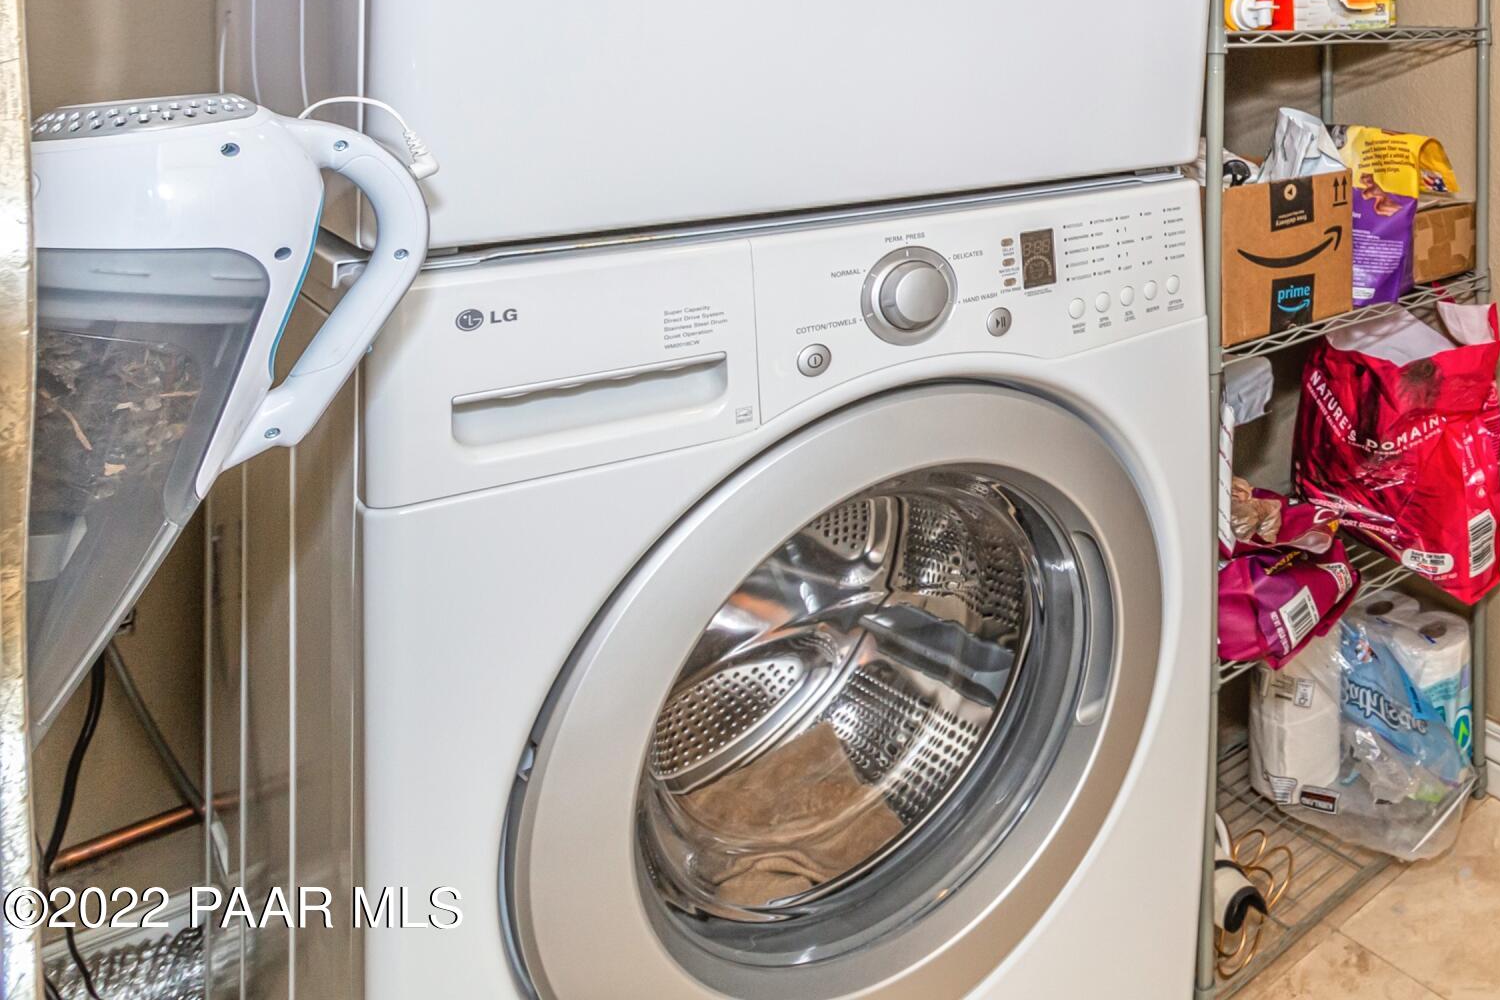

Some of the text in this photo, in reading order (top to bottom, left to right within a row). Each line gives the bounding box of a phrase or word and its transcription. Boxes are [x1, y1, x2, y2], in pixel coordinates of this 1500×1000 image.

[905, 231, 925, 241] PRESS
[952, 250, 984, 261] DELICATES
[830, 268, 861, 279] NORMAL
[962, 291, 998, 304] HAND WASH
[1277, 285, 1310, 304] prime
[683, 305, 711, 313] Capacity
[490, 308, 518, 325] LG
[701, 311, 724, 319] System
[663, 324, 692, 332] Stainless
[796, 317, 858, 335] COTTON/TOWELS
[682, 329, 713, 338] Operation
[1309, 370, 1440, 451] NATURE'S DOMAIN
[1359, 521, 1399, 535] DIGESTION
